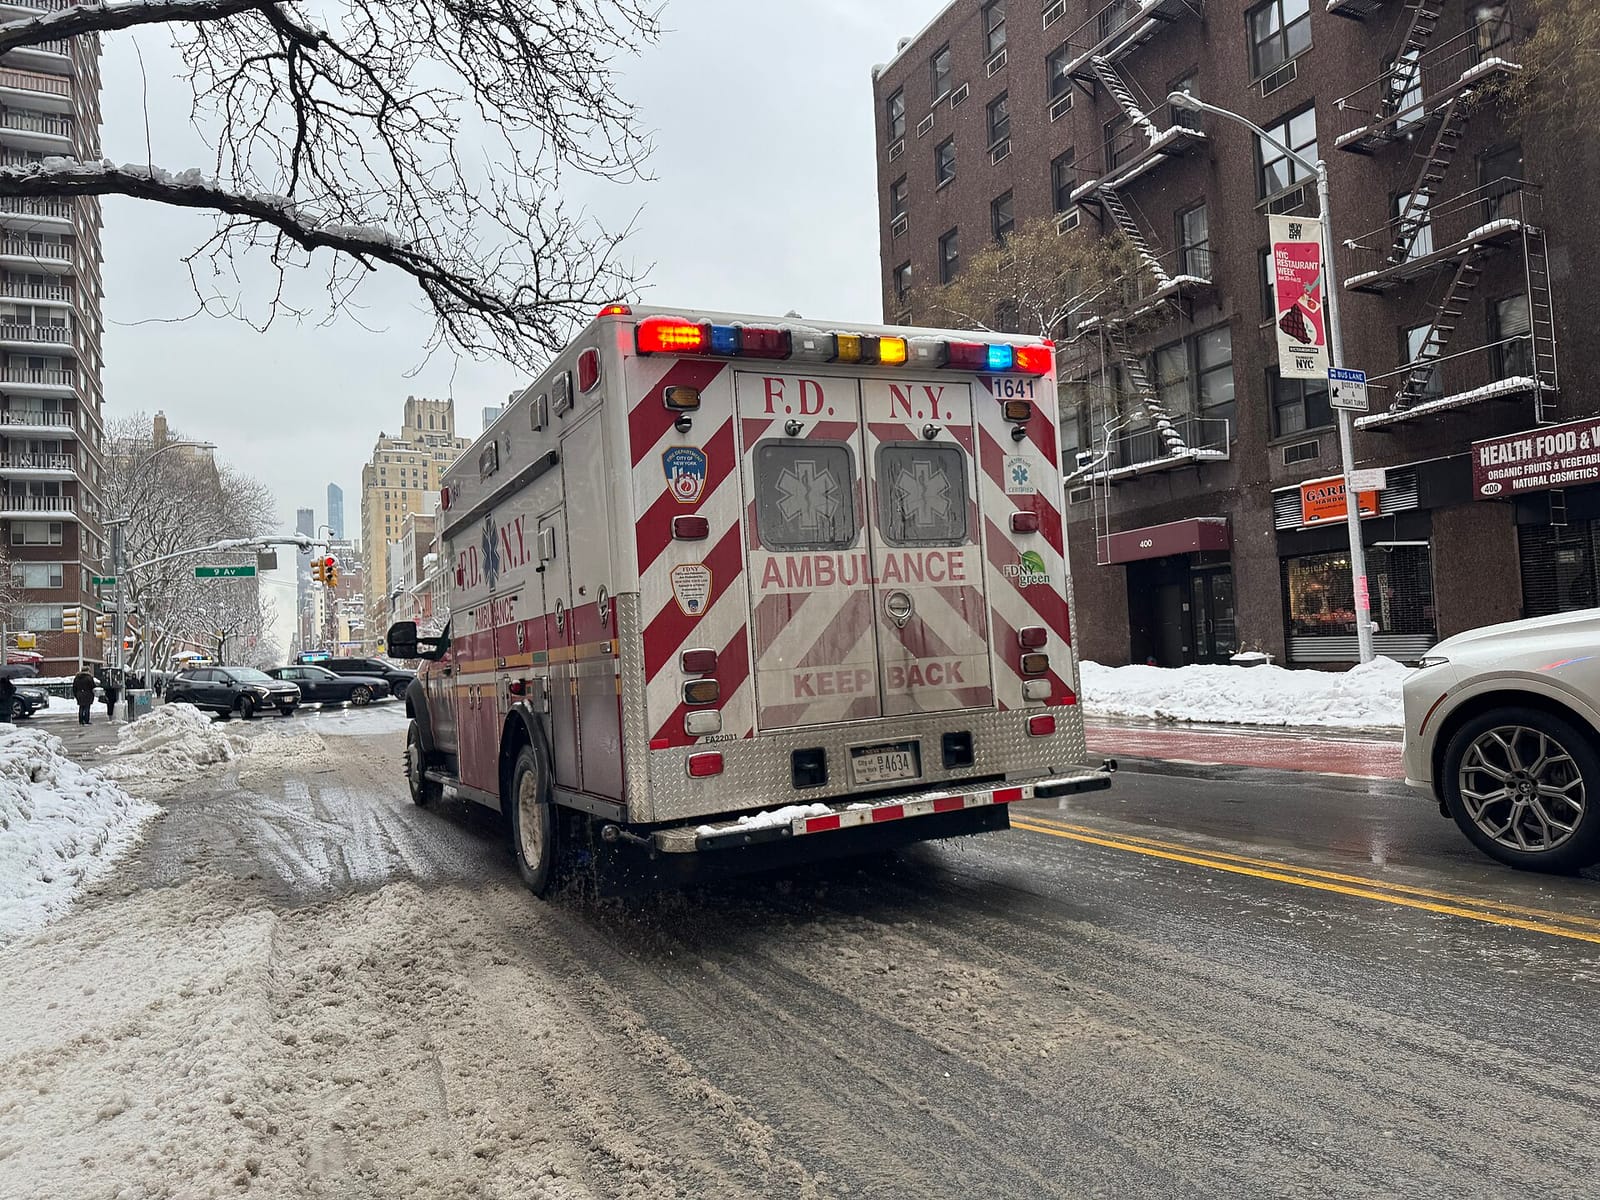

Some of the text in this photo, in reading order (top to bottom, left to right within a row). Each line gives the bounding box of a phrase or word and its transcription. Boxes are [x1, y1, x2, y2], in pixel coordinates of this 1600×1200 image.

[1276, 250, 1289, 259] NYC
[1276, 259, 1319, 270] RESTAURANT
[1277, 267, 1295, 276] WEEK
[1296, 359, 1314, 368] NYC
[1337, 371, 1363, 380] BUS LANE
[994, 379, 1034, 398] 1641
[763, 377, 952, 420] F.D. N.Y.
[1480, 440, 1532, 467] HEALTH
[1536, 431, 1577, 457] FOOD
[1580, 431, 1590, 450] &
[1488, 467, 1523, 480] ORGANIC
[1524, 461, 1552, 475] FRUITS
[1553, 461, 1560, 470] &
[1512, 467, 1599, 489] NATURAL COSMETICS
[1485, 484, 1499, 493] 400
[1316, 496, 1345, 505] HARDW
[501, 514, 530, 573] N.Y.
[1139, 539, 1153, 548] 400
[761, 551, 966, 589] AMBULANCE
[1003, 564, 1036, 576] FDNY
[1020, 574, 1050, 586] green
[794, 660, 966, 698] KEEP BACK
[885, 753, 910, 772] 4634
